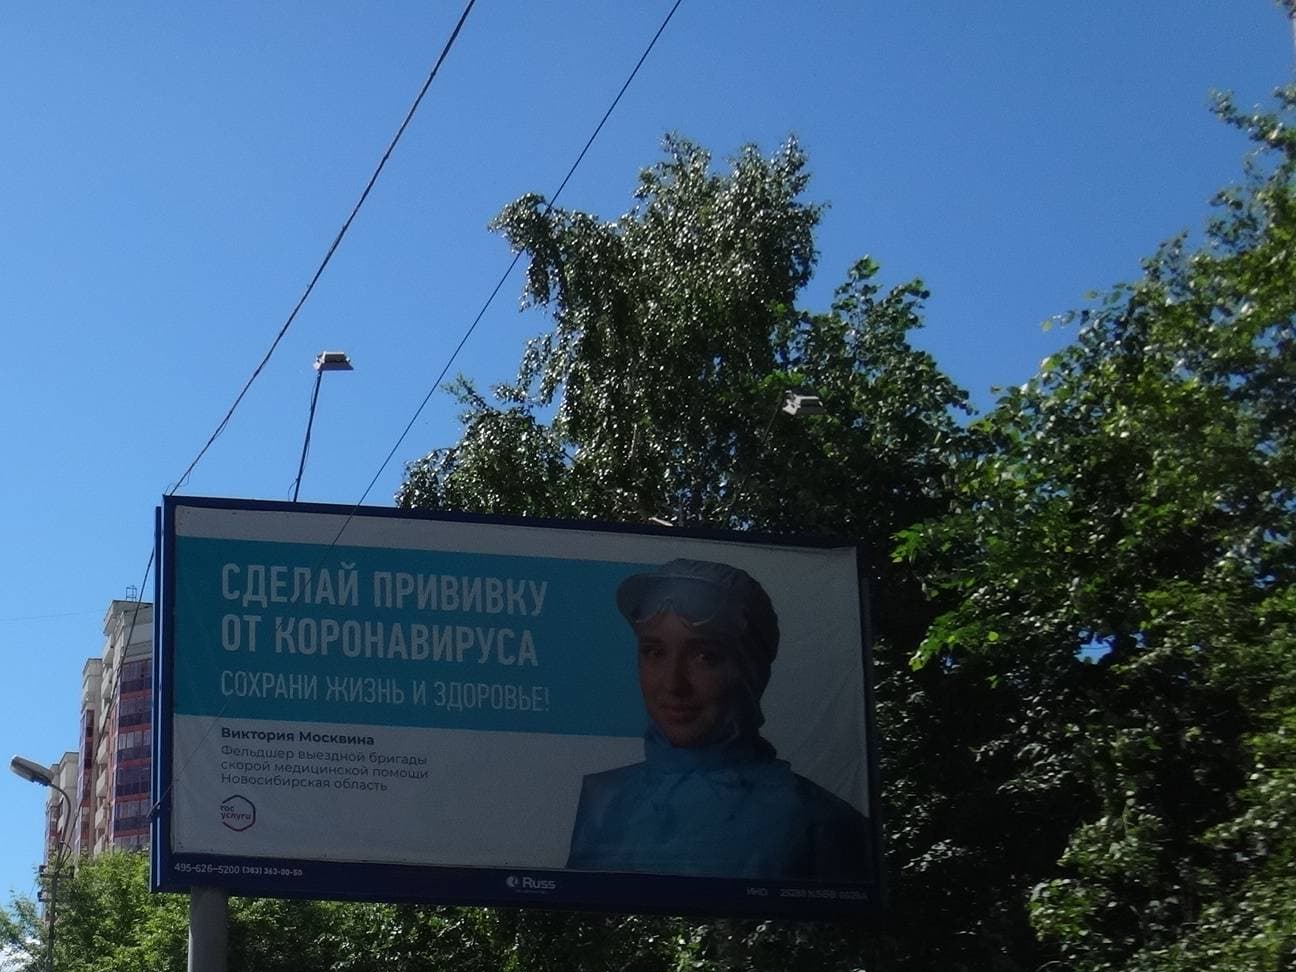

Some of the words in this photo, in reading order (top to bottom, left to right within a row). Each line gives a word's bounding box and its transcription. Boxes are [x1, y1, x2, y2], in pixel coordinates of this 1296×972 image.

[221, 562, 359, 608] СДЕЛАЙ
[373, 571, 548, 616] ПРИВИВКУ
[221, 614, 262, 652] ОТ
[275, 616, 538, 667] КОРОНАВИРУСА
[221, 670, 318, 700] СОХРАНИ
[326, 676, 404, 704] ЖИЗНЬ
[413, 680, 427, 705] И
[433, 681, 551, 712] ЗДОРОВЬЕ!
[221, 727, 295, 743] Виктория
[299, 731, 375, 746] Москвина
[221, 745, 295, 761] Фельдшер
[298, 750, 366, 763] выездной
[368, 751, 428, 766] бригады
[221, 761, 271, 774] скорой
[274, 764, 369, 778] медицинской
[372, 769, 429, 780] помощи
[221, 773, 331, 789] Новосибирская
[334, 778, 388, 792] область
[174, 863, 240, 875] 495-626-5200
[522, 876, 556, 889] Russ
